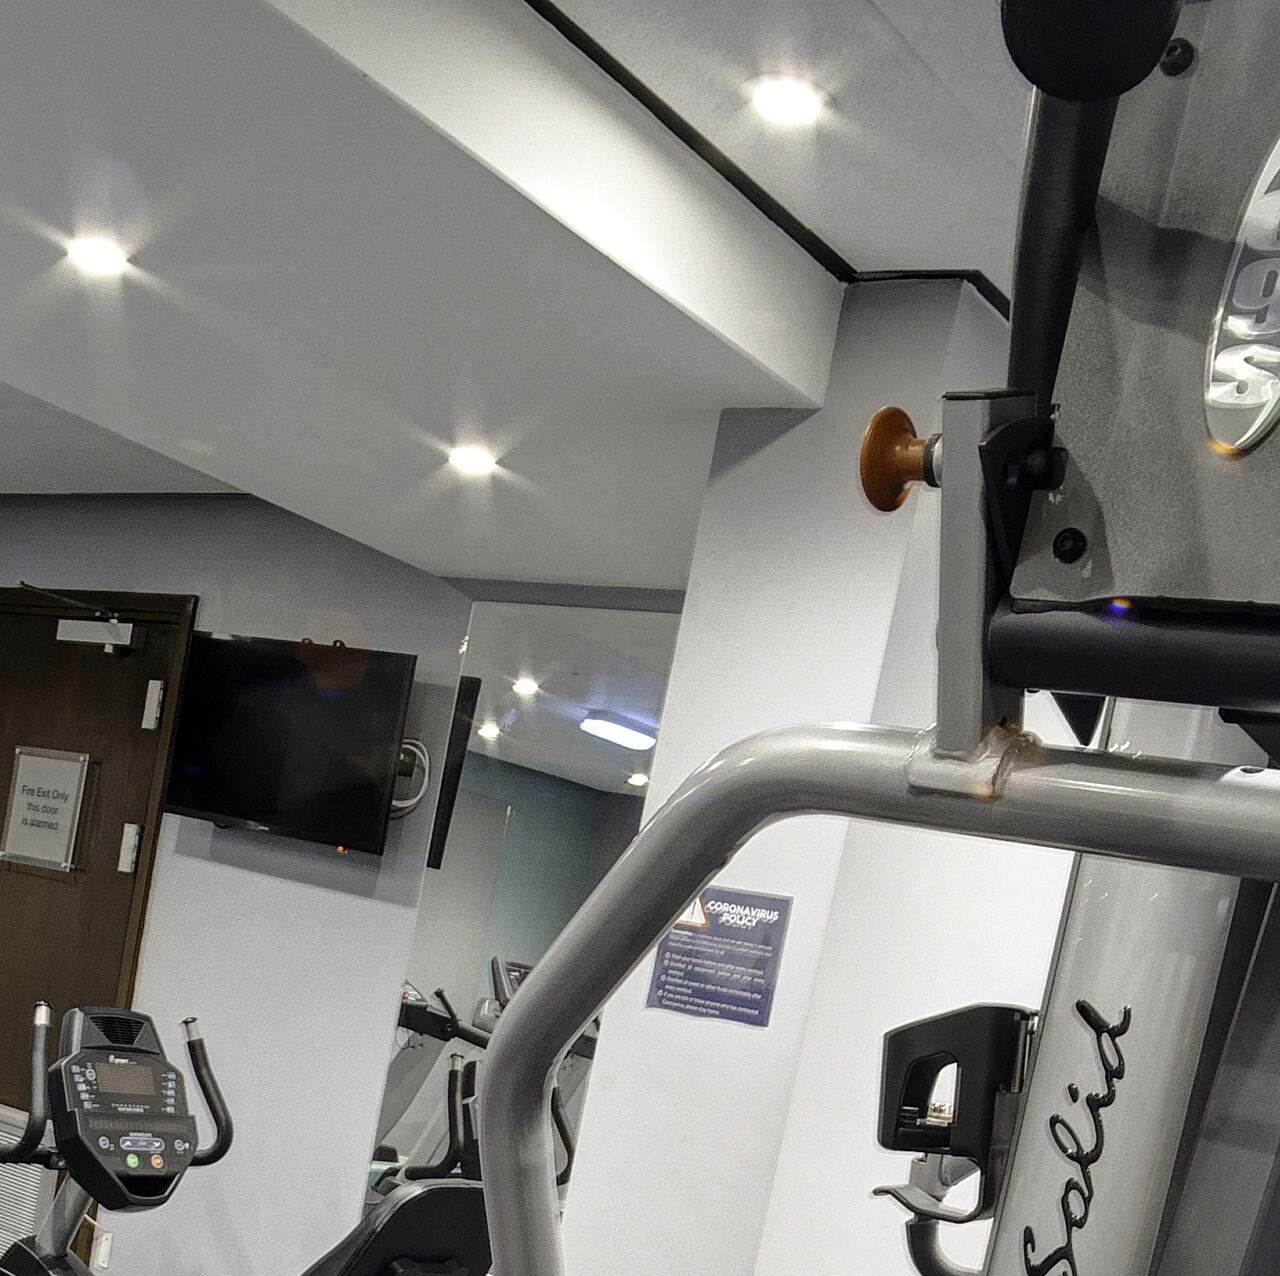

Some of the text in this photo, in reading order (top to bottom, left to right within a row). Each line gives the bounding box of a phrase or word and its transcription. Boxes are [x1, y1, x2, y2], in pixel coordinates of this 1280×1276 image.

[21, 784, 70, 804] Fire Exit Only
[26, 802, 59, 815] this door
[29, 818, 59, 830] alarmed
[707, 900, 780, 921] CORONAVIRUS
[722, 912, 759, 927] POLICY
